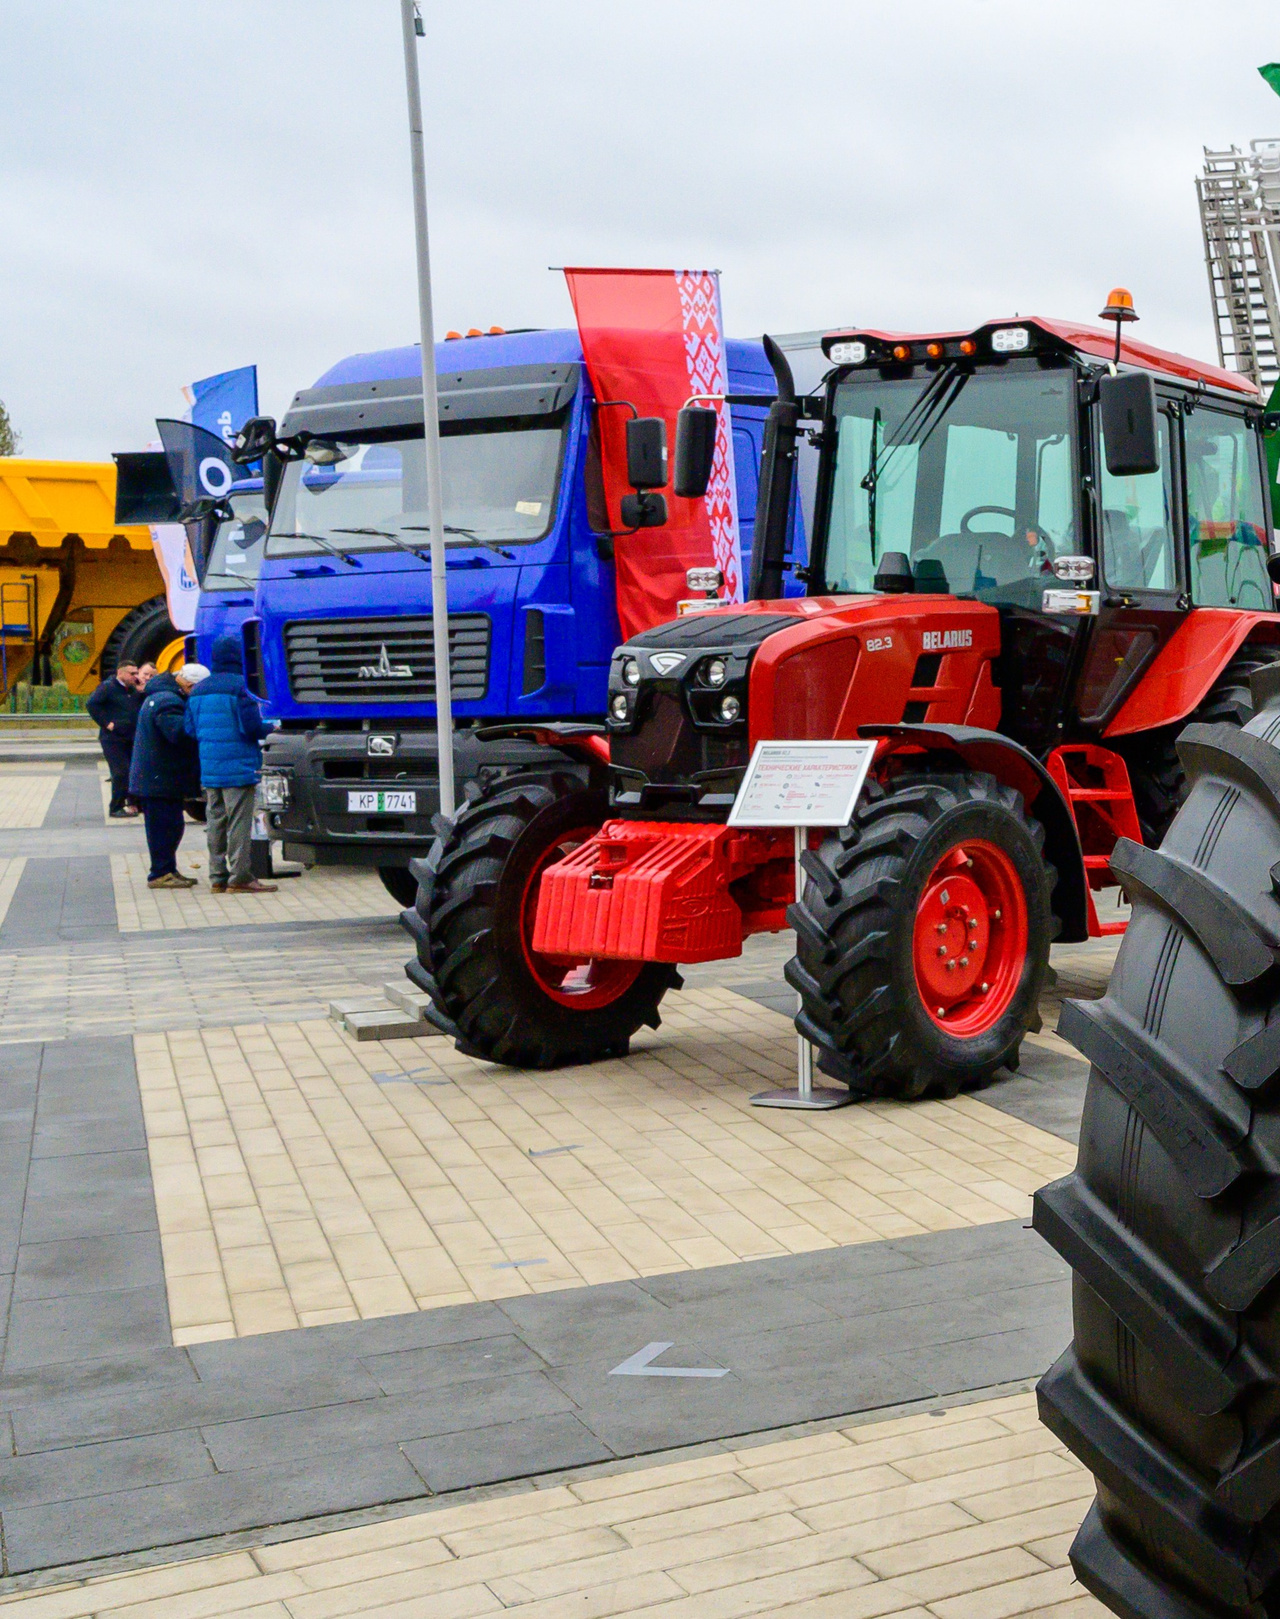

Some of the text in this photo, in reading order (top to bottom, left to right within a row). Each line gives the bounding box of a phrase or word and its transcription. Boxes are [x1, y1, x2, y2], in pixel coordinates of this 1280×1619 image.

[866, 636, 893, 652] 82.3
[922, 629, 973, 650] BELARUS
[387, 794, 413, 809] 7741
